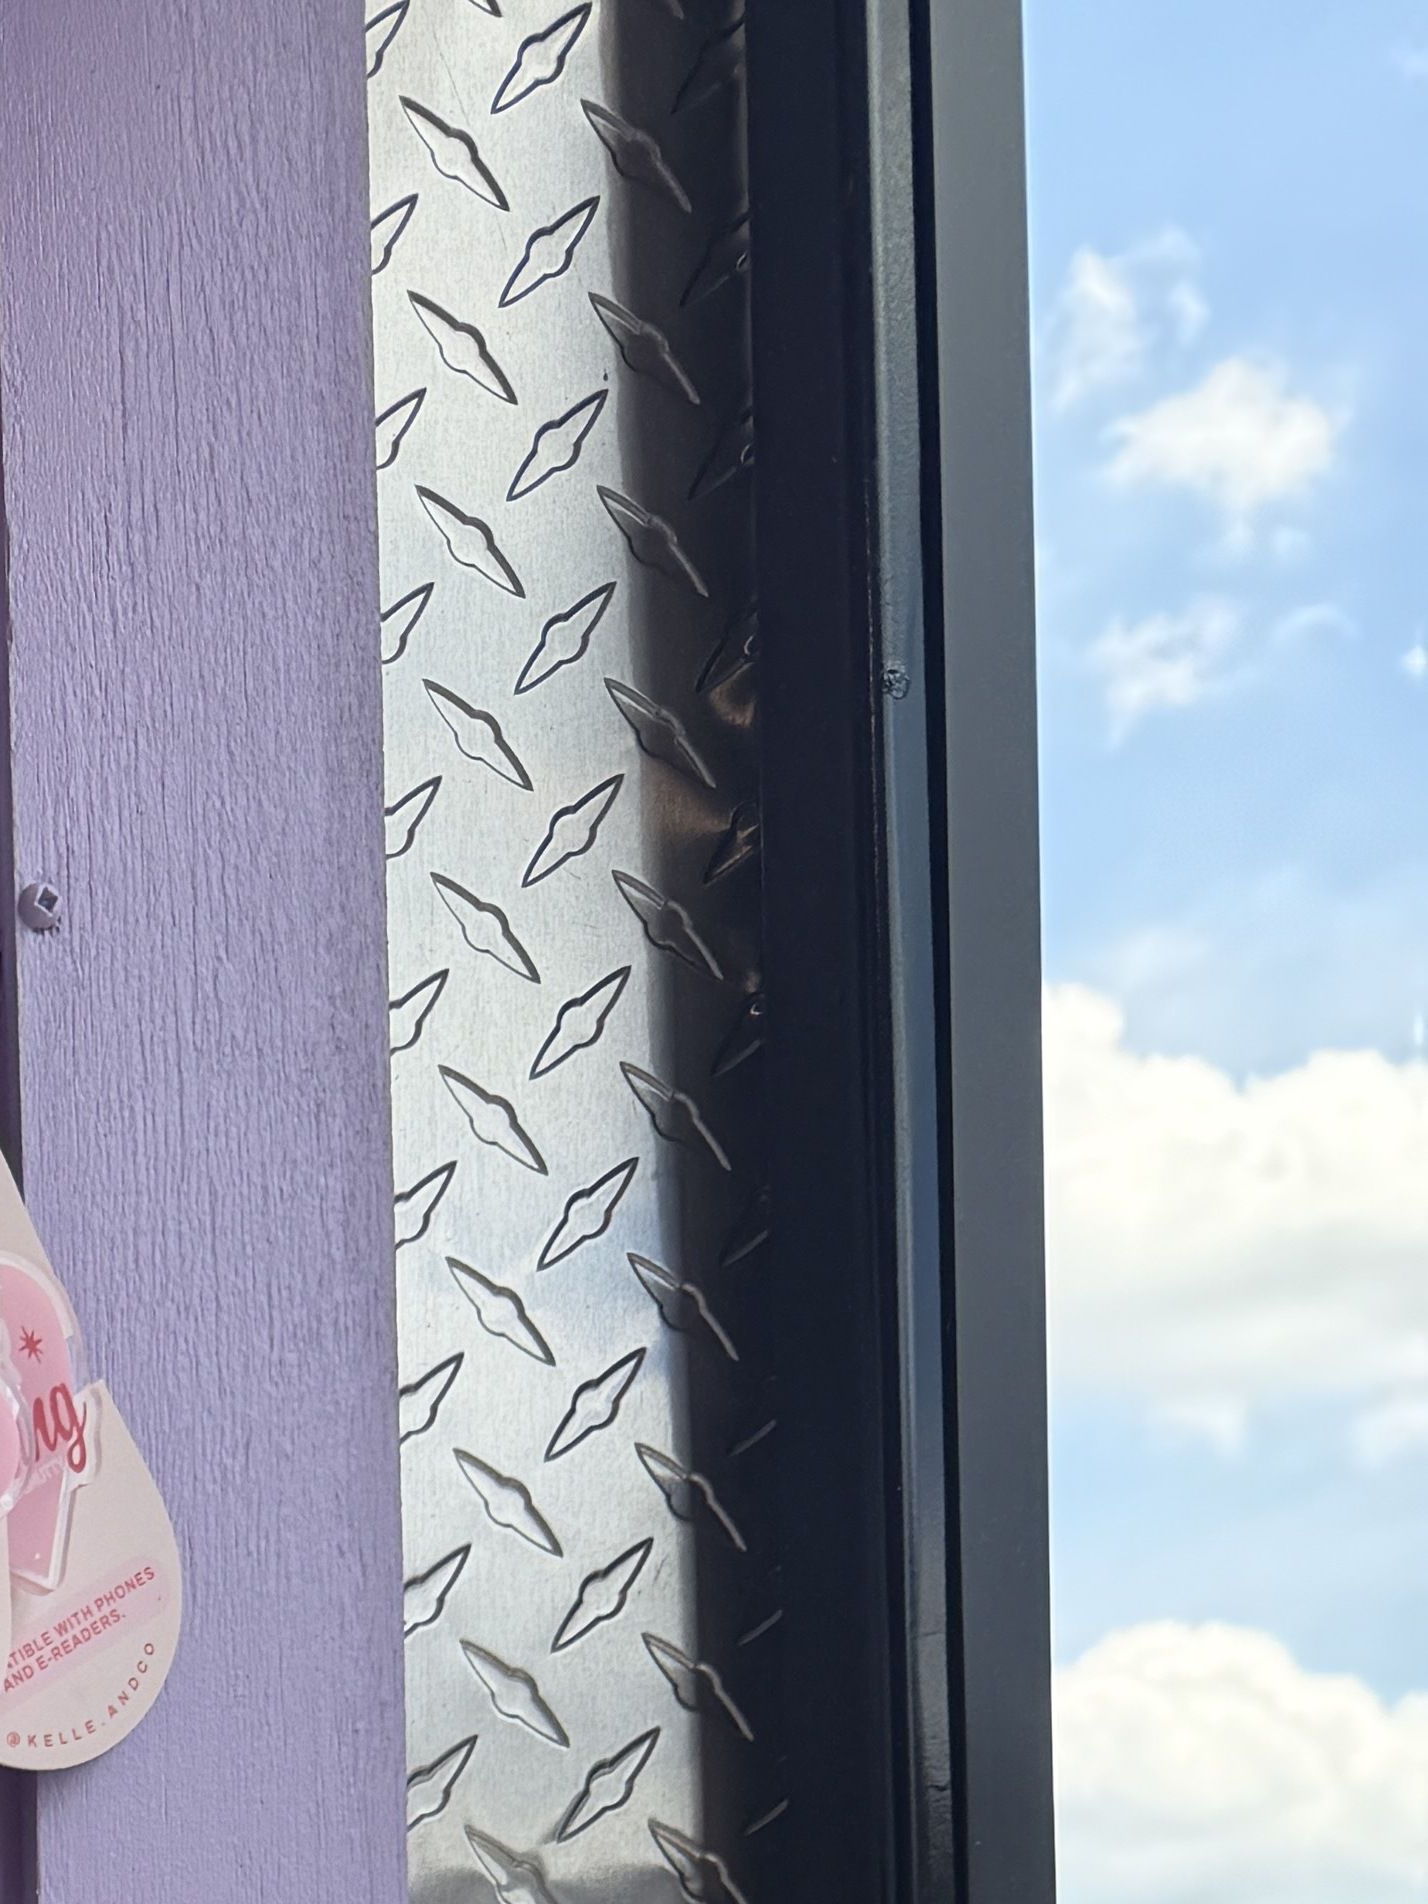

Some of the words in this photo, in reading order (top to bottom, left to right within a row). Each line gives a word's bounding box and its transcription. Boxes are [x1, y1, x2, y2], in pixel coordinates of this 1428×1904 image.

[54, 1604, 95, 1638] WITH
[94, 1566, 156, 1613] PHONES
[3, 1664, 36, 1694] AND
